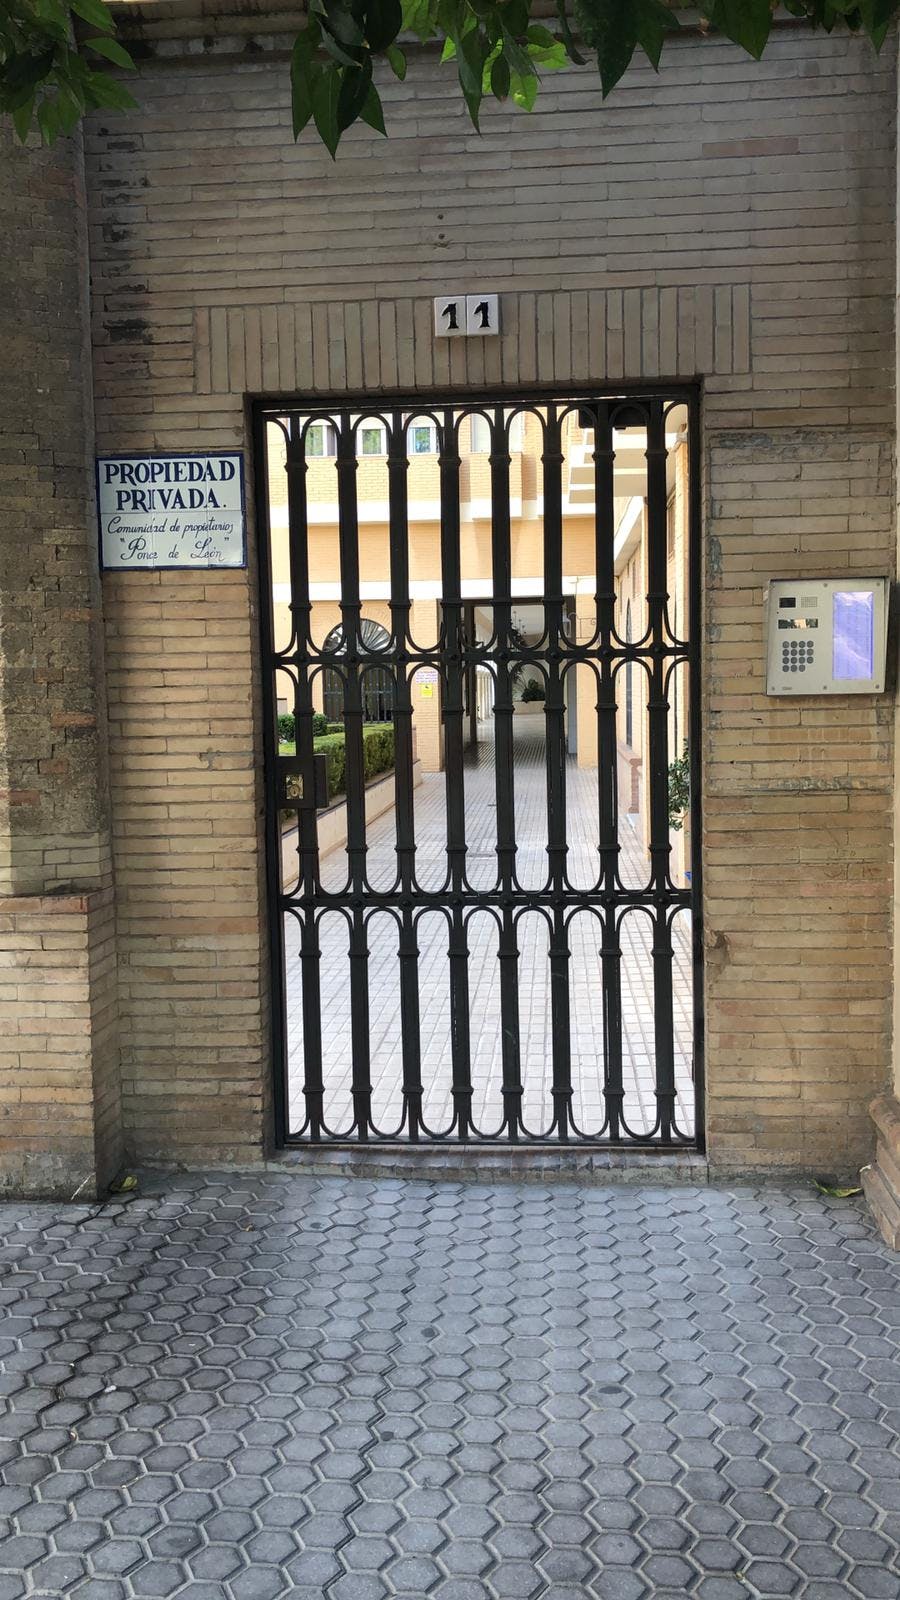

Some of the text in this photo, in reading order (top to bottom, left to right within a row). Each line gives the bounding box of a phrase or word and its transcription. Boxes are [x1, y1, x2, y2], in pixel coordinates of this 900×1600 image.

[442, 302, 490, 329] 11
[104, 460, 236, 486] PROPIEDAD
[116, 488, 227, 512] PRIVADA.
[108, 516, 168, 534] Comunidad
[170, 518, 181, 532] de
[168, 544, 179, 558] de
